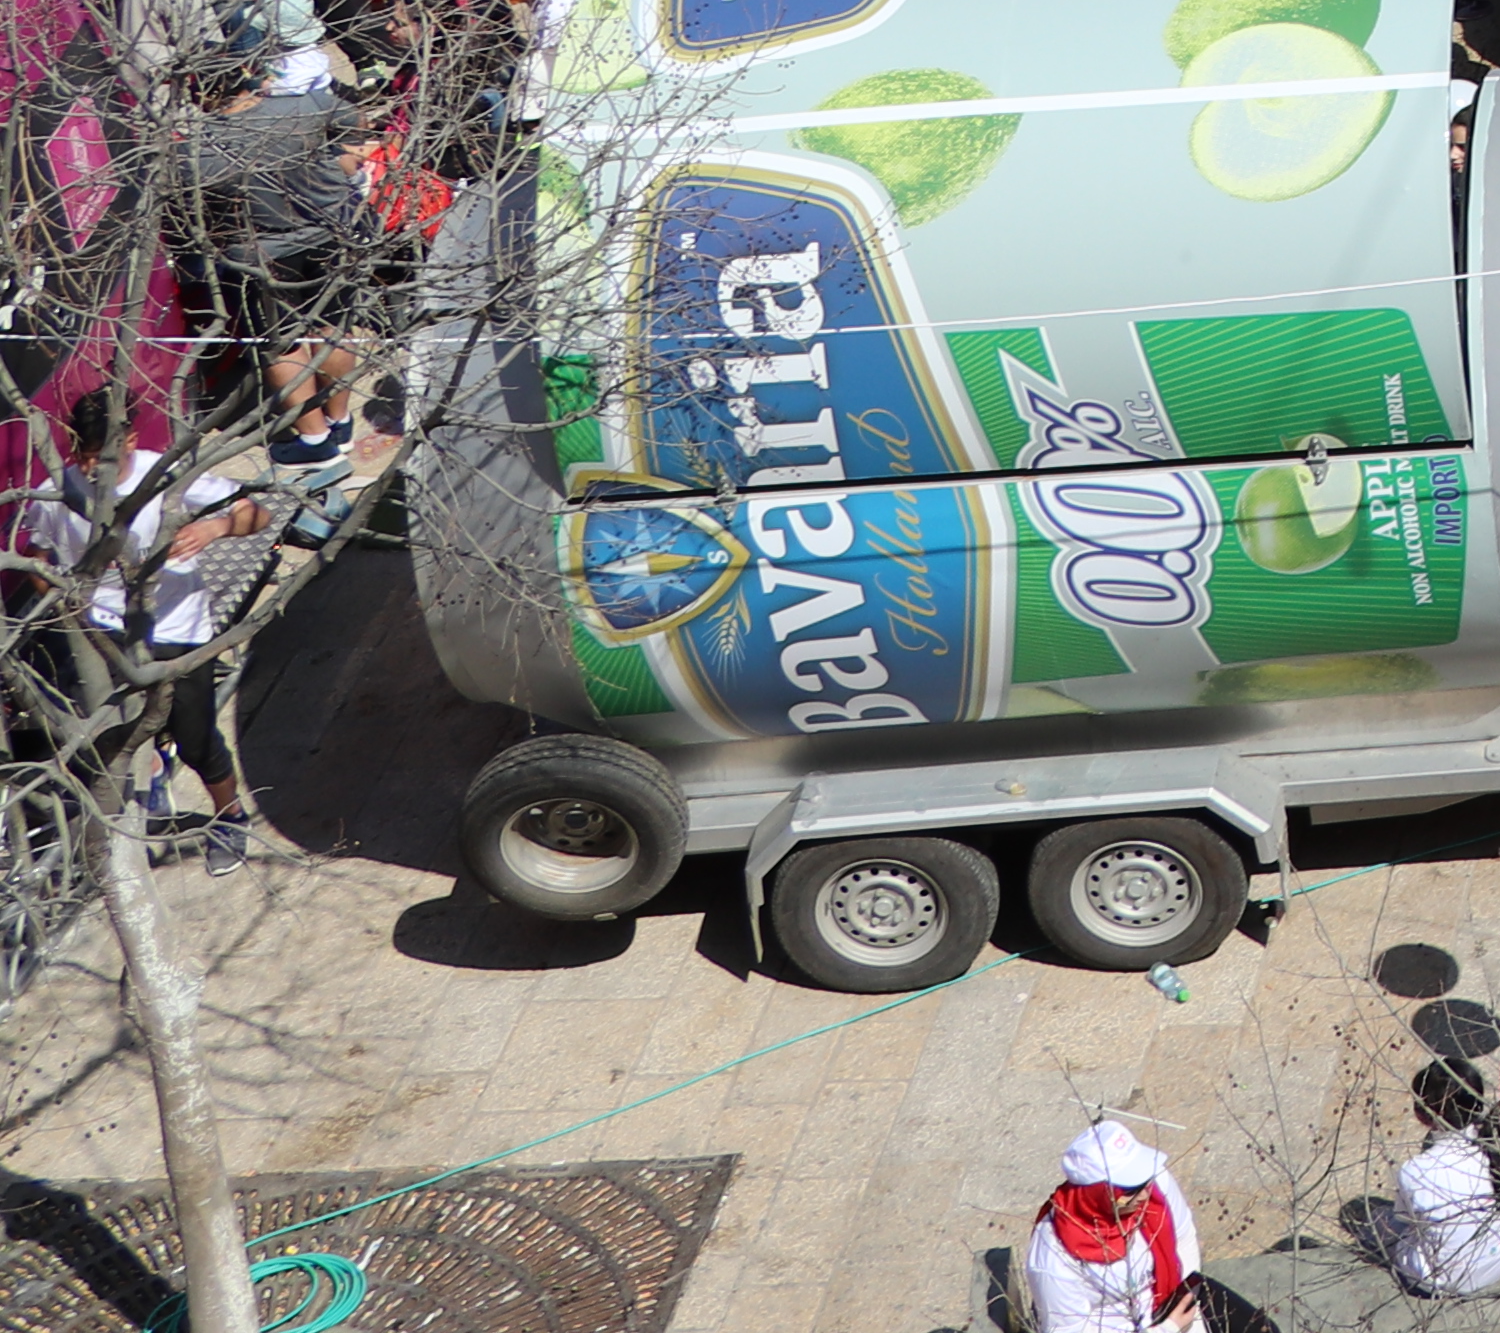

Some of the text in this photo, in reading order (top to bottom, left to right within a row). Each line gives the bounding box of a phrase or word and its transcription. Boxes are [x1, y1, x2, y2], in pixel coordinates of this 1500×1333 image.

[1124, 390, 1173, 452] ALC.
[1381, 371, 1408, 425] DRINK
[689, 239, 931, 735] Bavaria
[1397, 472, 1430, 570] ALCOHOLIC
[846, 406, 949, 659] Holland
[1413, 567, 1434, 607] NON
